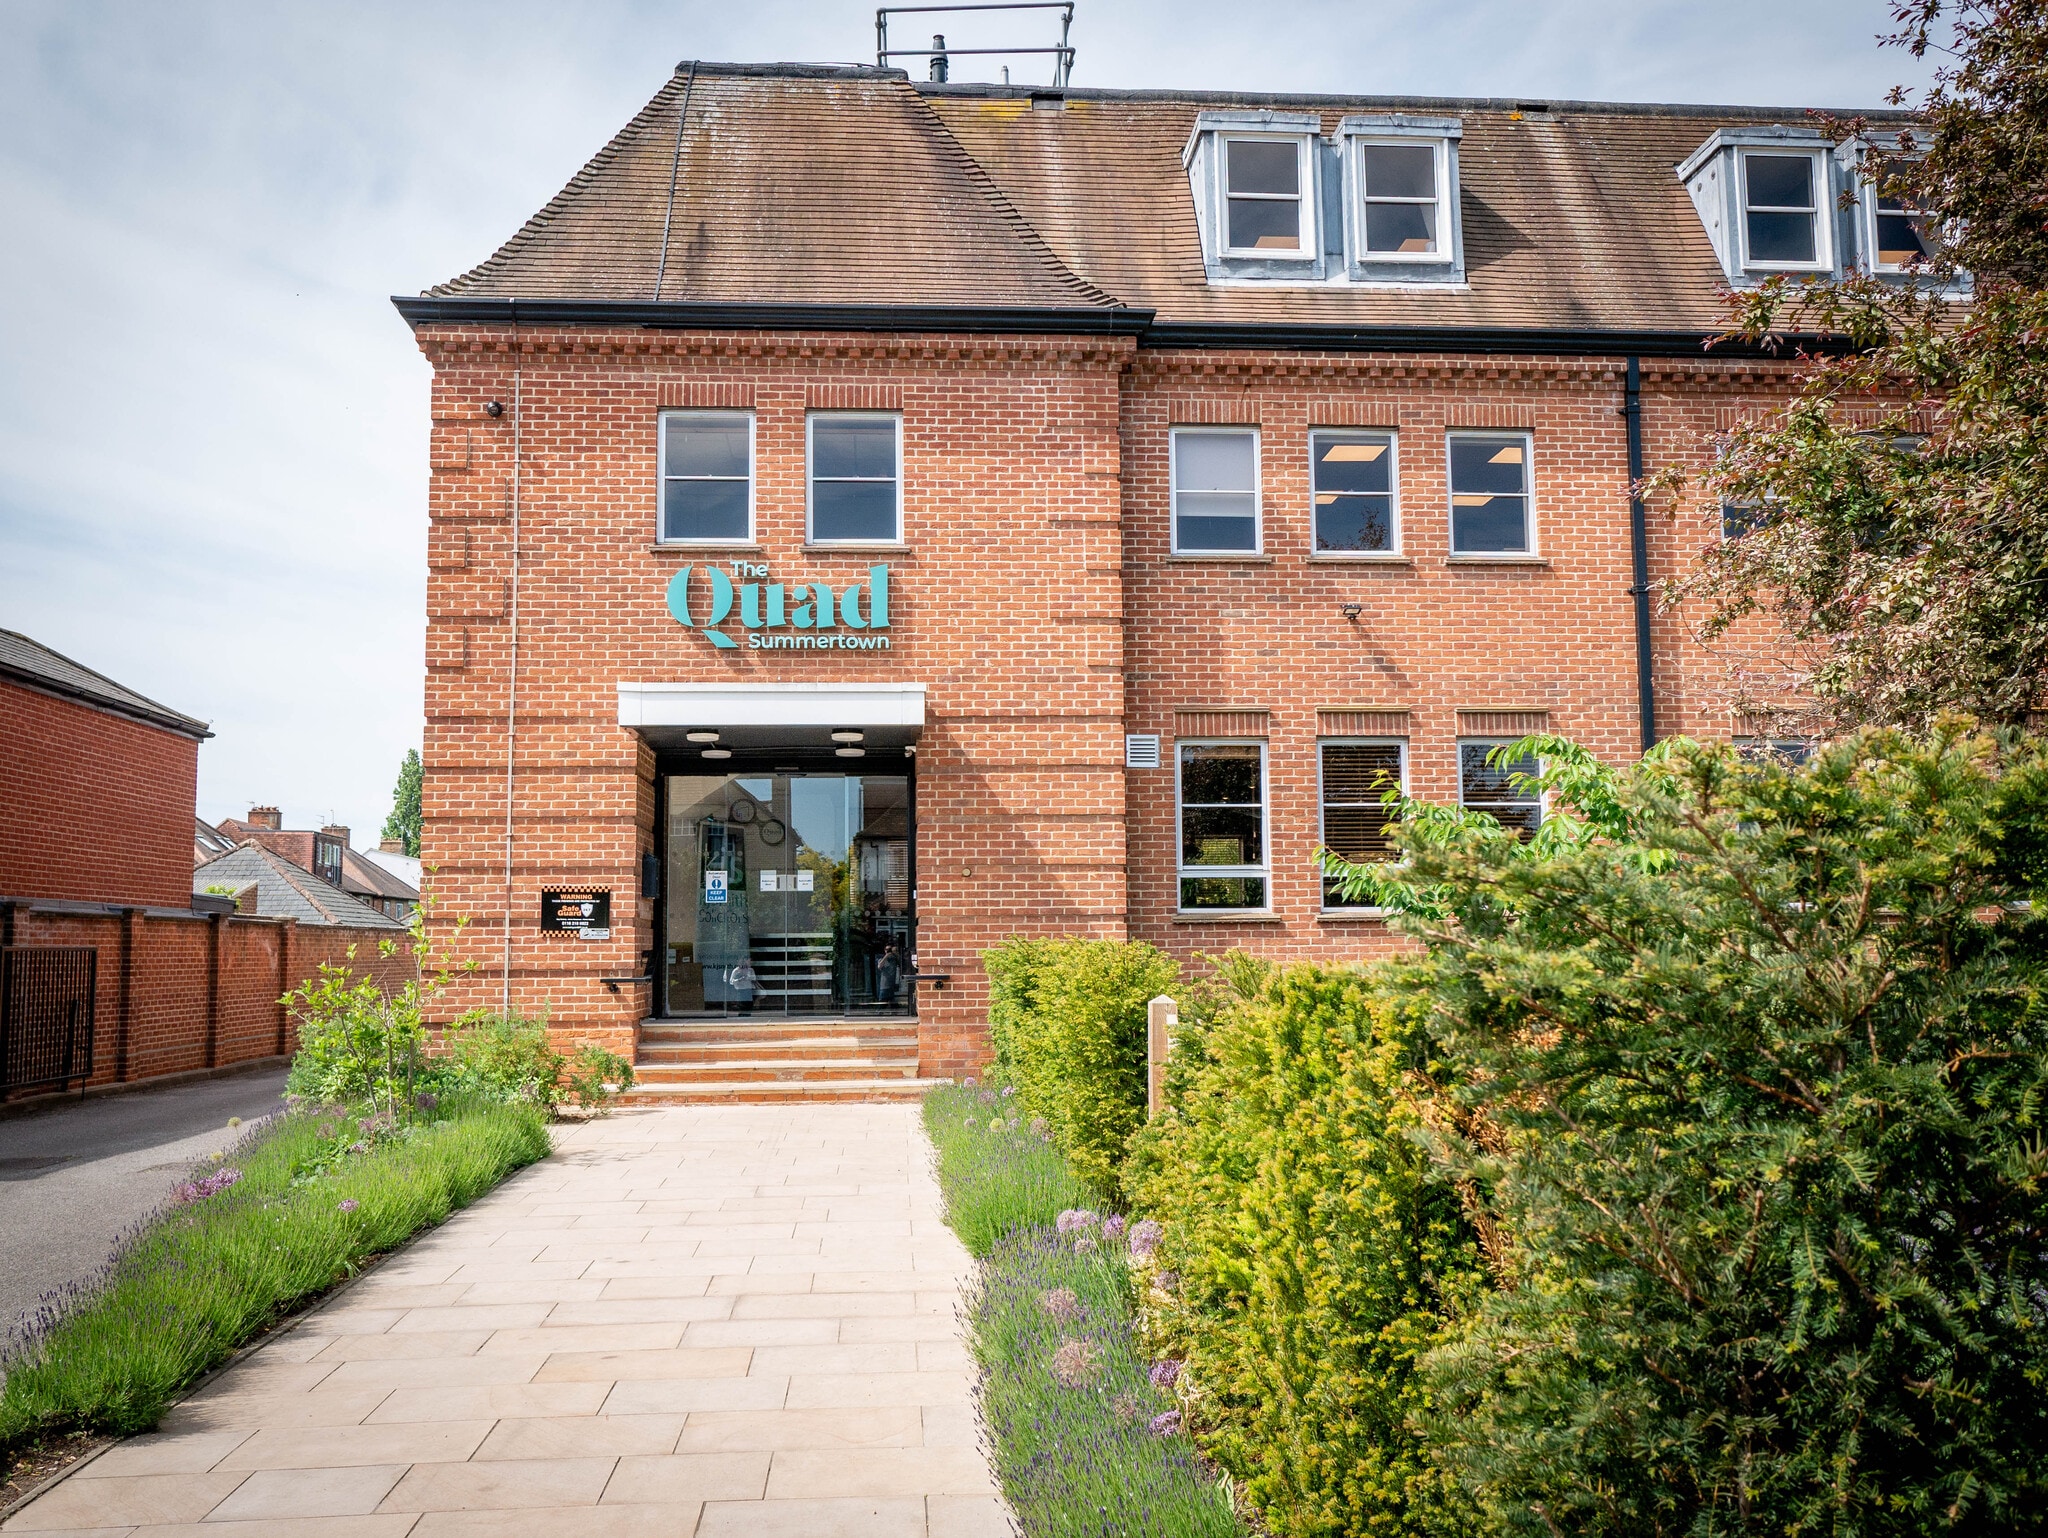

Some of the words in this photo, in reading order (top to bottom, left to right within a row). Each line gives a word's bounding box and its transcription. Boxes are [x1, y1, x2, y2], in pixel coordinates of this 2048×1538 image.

[730, 560, 768, 577] The
[667, 563, 891, 648] Quad
[748, 632, 890, 650] Summertown
